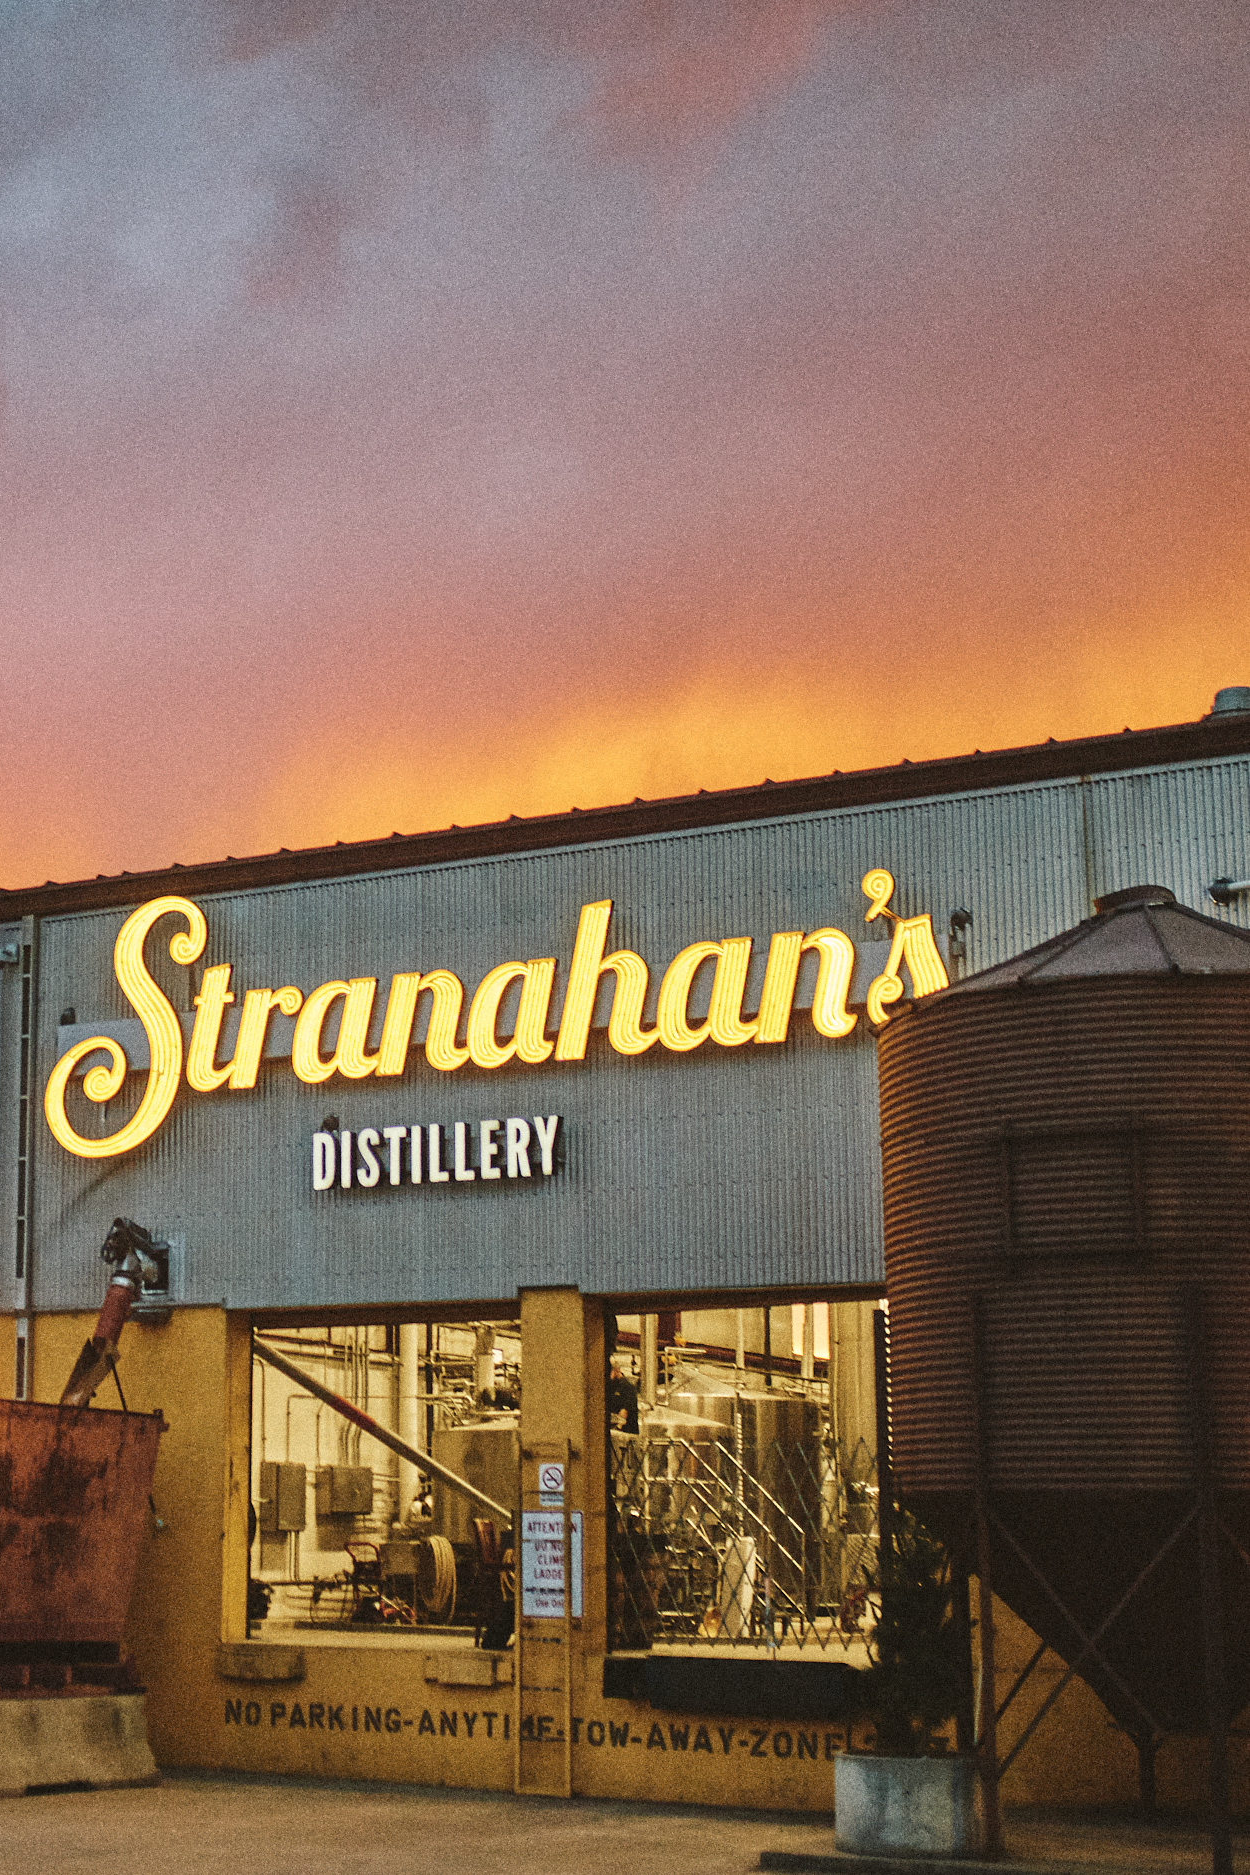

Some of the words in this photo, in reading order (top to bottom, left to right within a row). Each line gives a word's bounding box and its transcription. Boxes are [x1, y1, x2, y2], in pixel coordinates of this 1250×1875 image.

[44, 868, 950, 1159] Stranahan's
[312, 1114, 559, 1190] DISTILLERY
[534, 1569, 564, 1580] LADDE
